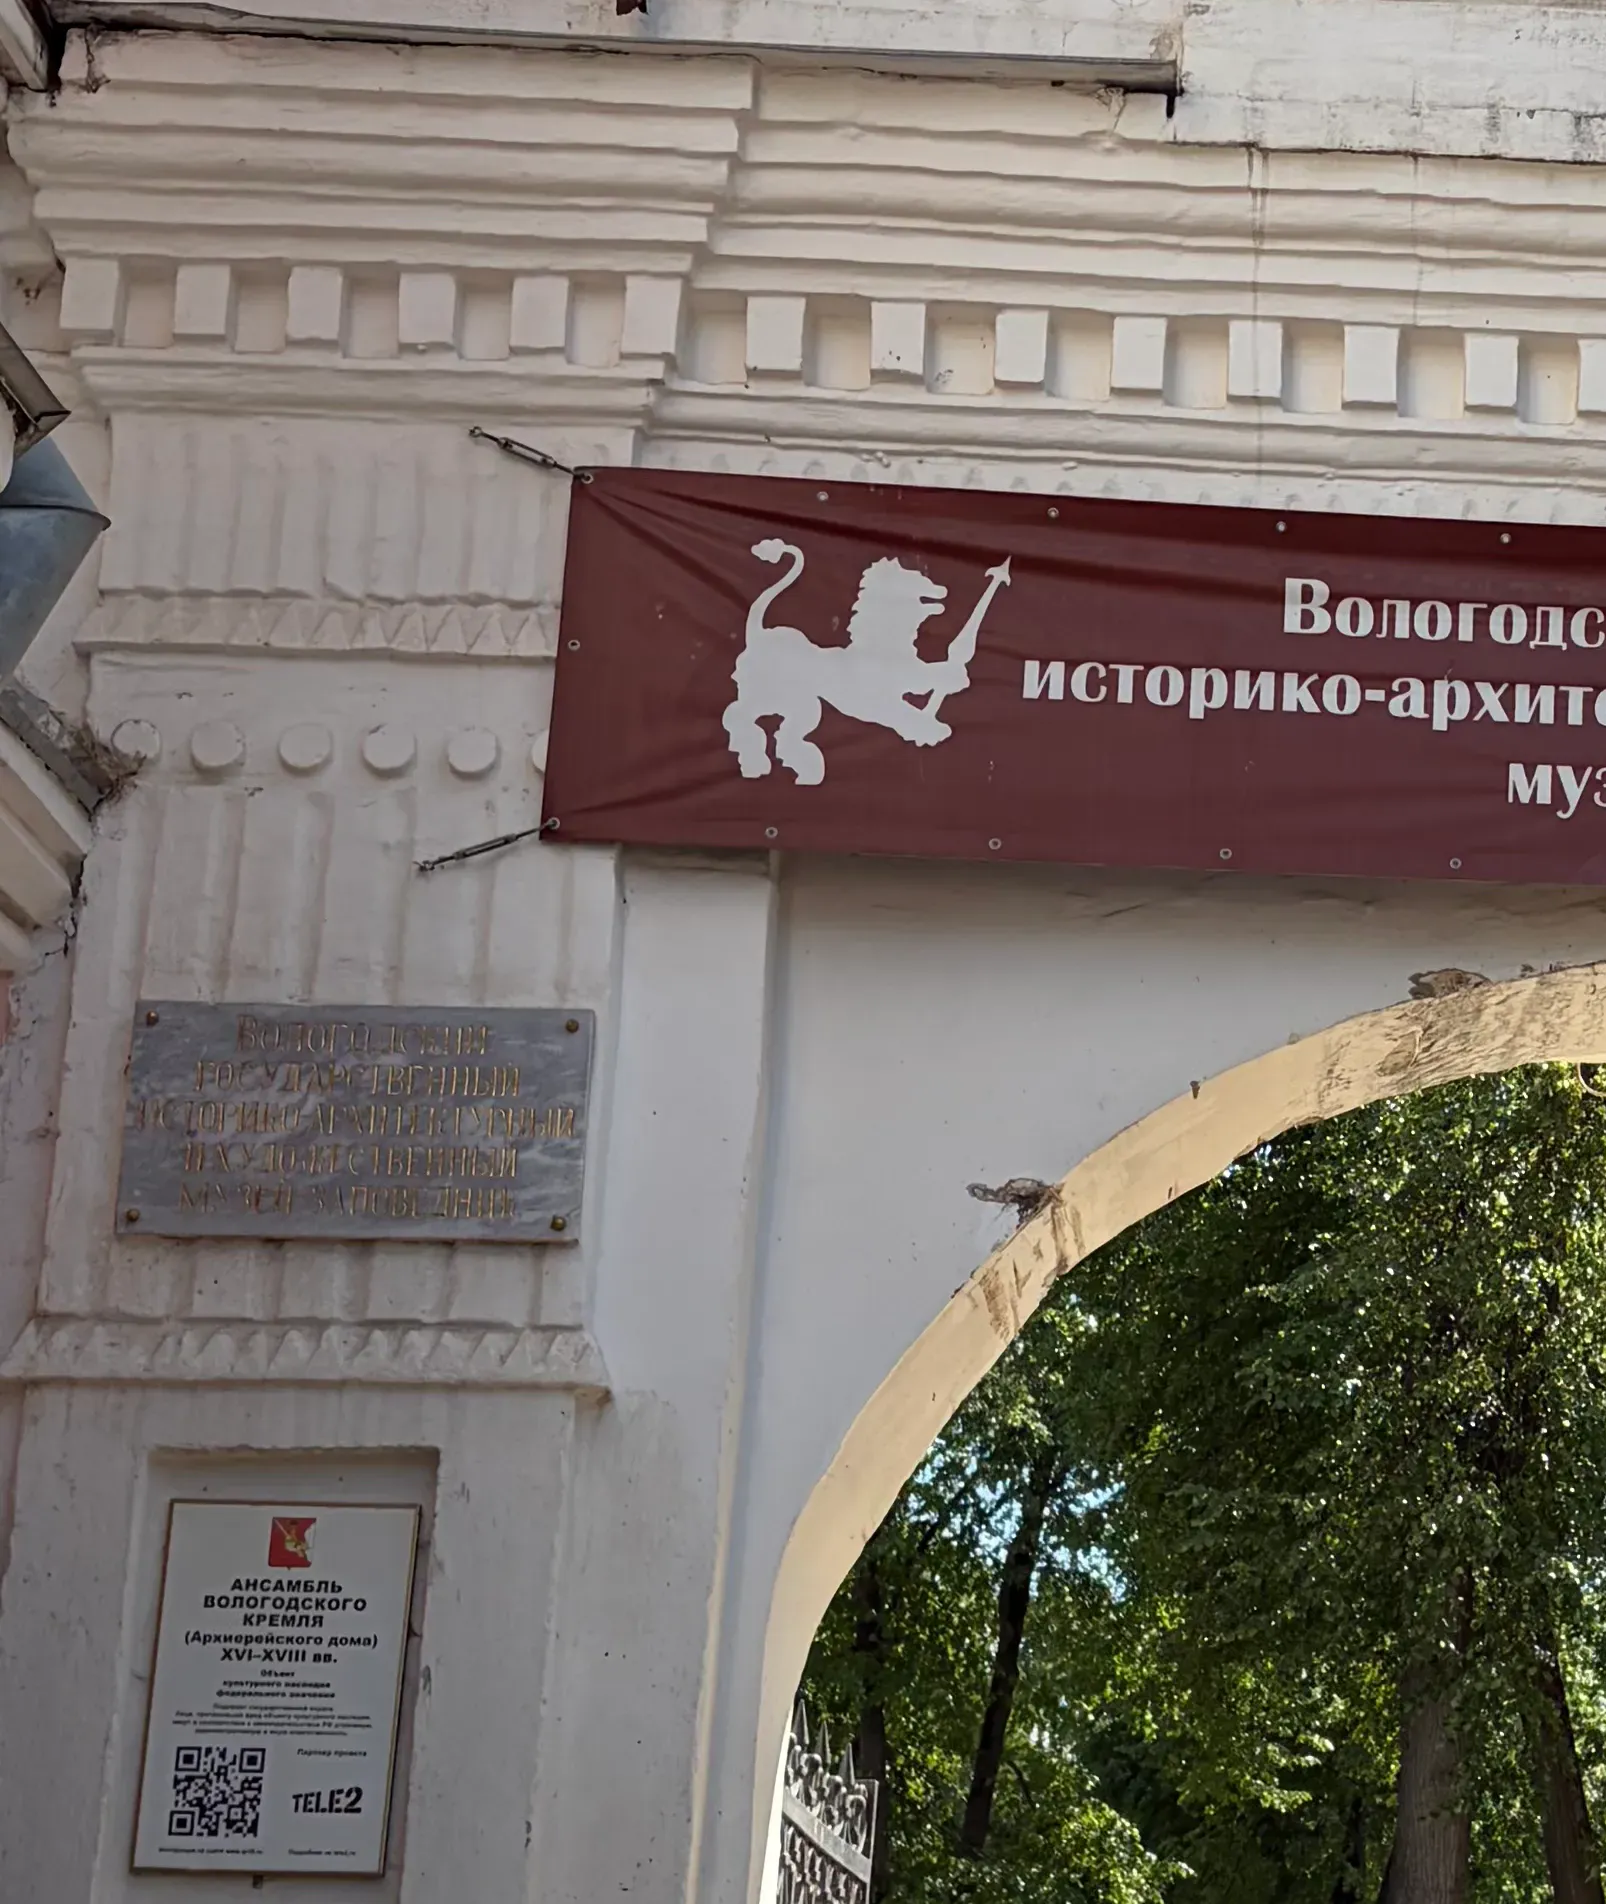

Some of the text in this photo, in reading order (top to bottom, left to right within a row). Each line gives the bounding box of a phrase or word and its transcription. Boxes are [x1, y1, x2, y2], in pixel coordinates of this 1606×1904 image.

[230, 1577, 343, 1594] АНСАМБЛЬ
[203, 1594, 368, 1613] ВОЛОГОДСКОГО
[242, 1612, 324, 1629] КРЕМЛЯ
[327, 1633, 379, 1650] дома)
[312, 1651, 338, 1664] вв.
[291, 1785, 364, 1814] TELE2
